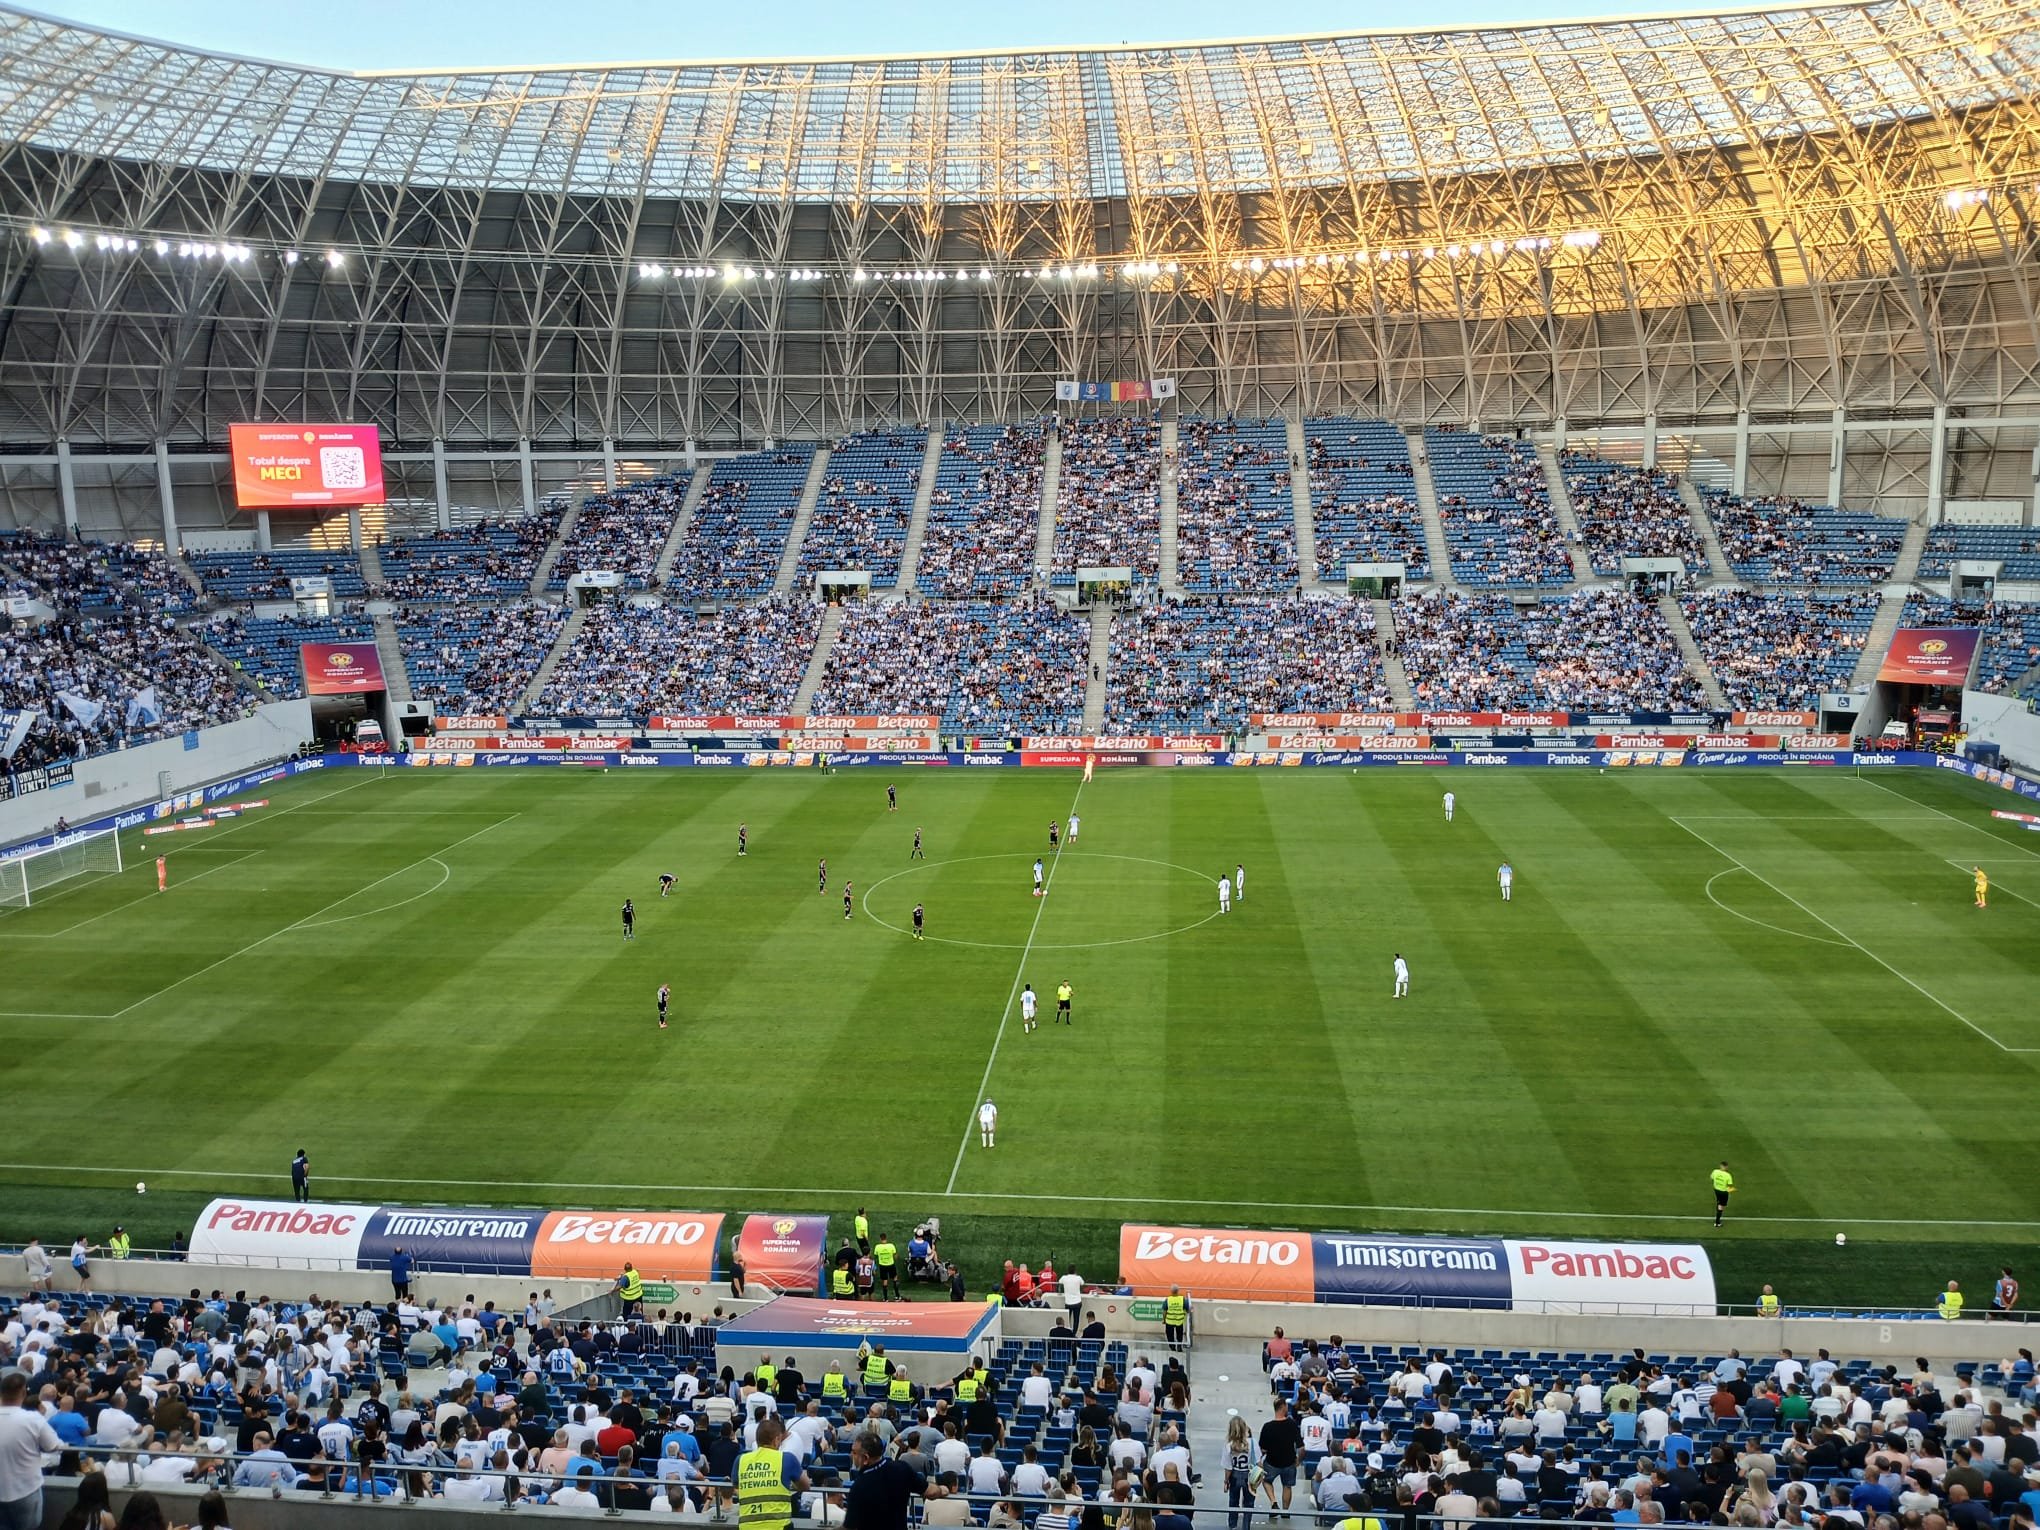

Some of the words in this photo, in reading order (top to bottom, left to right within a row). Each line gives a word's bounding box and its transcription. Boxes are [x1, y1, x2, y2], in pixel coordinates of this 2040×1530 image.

[248, 456, 275, 465] Totul
[278, 456, 311, 468] despre
[260, 467, 302, 480] MECI
[447, 717, 497, 729] Betano
[663, 717, 708, 728] Pambac
[735, 717, 780, 728] Pambac
[805, 716, 856, 729] Betano
[877, 715, 928, 729] Betano
[1262, 714, 1317, 727] Betano
[1340, 714, 1396, 727] Betano
[1421, 714, 1471, 726] Pambac
[1501, 714, 1552, 726] Pambac
[1744, 712, 1802, 726] Betano
[425, 737, 475, 750] Betano
[500, 737, 545, 749] Pambac
[572, 737, 617, 749] Pambac
[793, 737, 843, 750] Betano
[1094, 737, 1148, 749] Betano
[1280, 735, 1337, 748] Betano
[1360, 735, 1417, 748] Betano
[1612, 735, 1664, 747] Pambac
[1696, 735, 1749, 747] Pambac
[359, 754, 396, 765] Pambac
[567, 753, 577, 761] ÎN
[578, 753, 605, 761] ROMÂNIA
[621, 754, 658, 765] Pambac
[693, 754, 731, 765] Pambac
[907, 753, 915, 761] ÎN
[916, 753, 948, 761] ROMÂNIA
[964, 754, 1003, 765] Pambac
[1175, 754, 1215, 765] Pambac
[1404, 752, 1414, 761] ÎN
[1416, 752, 1448, 761] ROMÂNIA
[1465, 753, 1508, 765] Pambac
[1547, 753, 1591, 765] Pambac
[1788, 752, 1798, 761] ÎN
[1800, 752, 1835, 761] ROMÂNIA
[1853, 753, 1896, 765] Pambac
[295, 758, 324, 773] Pambac
[1936, 755, 1967, 772] Pambac
[115, 812, 146, 829] Pambac
[54, 831, 86, 848] Pambac
[207, 1204, 356, 1236] Pambac
[548, 1215, 705, 1245] Betano
[1135, 1231, 1300, 1266] Betano
[1519, 1246, 1696, 1280] Pambac
[859, 1264, 872, 1277] 16
[581, 1285, 593, 1300] D
[2006, 1284, 2013, 1297] 3
[1213, 1307, 1229, 1323] C
[1880, 1326, 1893, 1343] B
[553, 1358, 564, 1370] 10
[1333, 1413, 1344, 1428] 14
[746, 1462, 770, 1471] ARD
[1232, 1454, 1249, 1470] 12
[740, 1470, 777, 1480] SECURITY
[740, 1479, 778, 1490] STEWARD
[751, 1503, 763, 1514] 21
